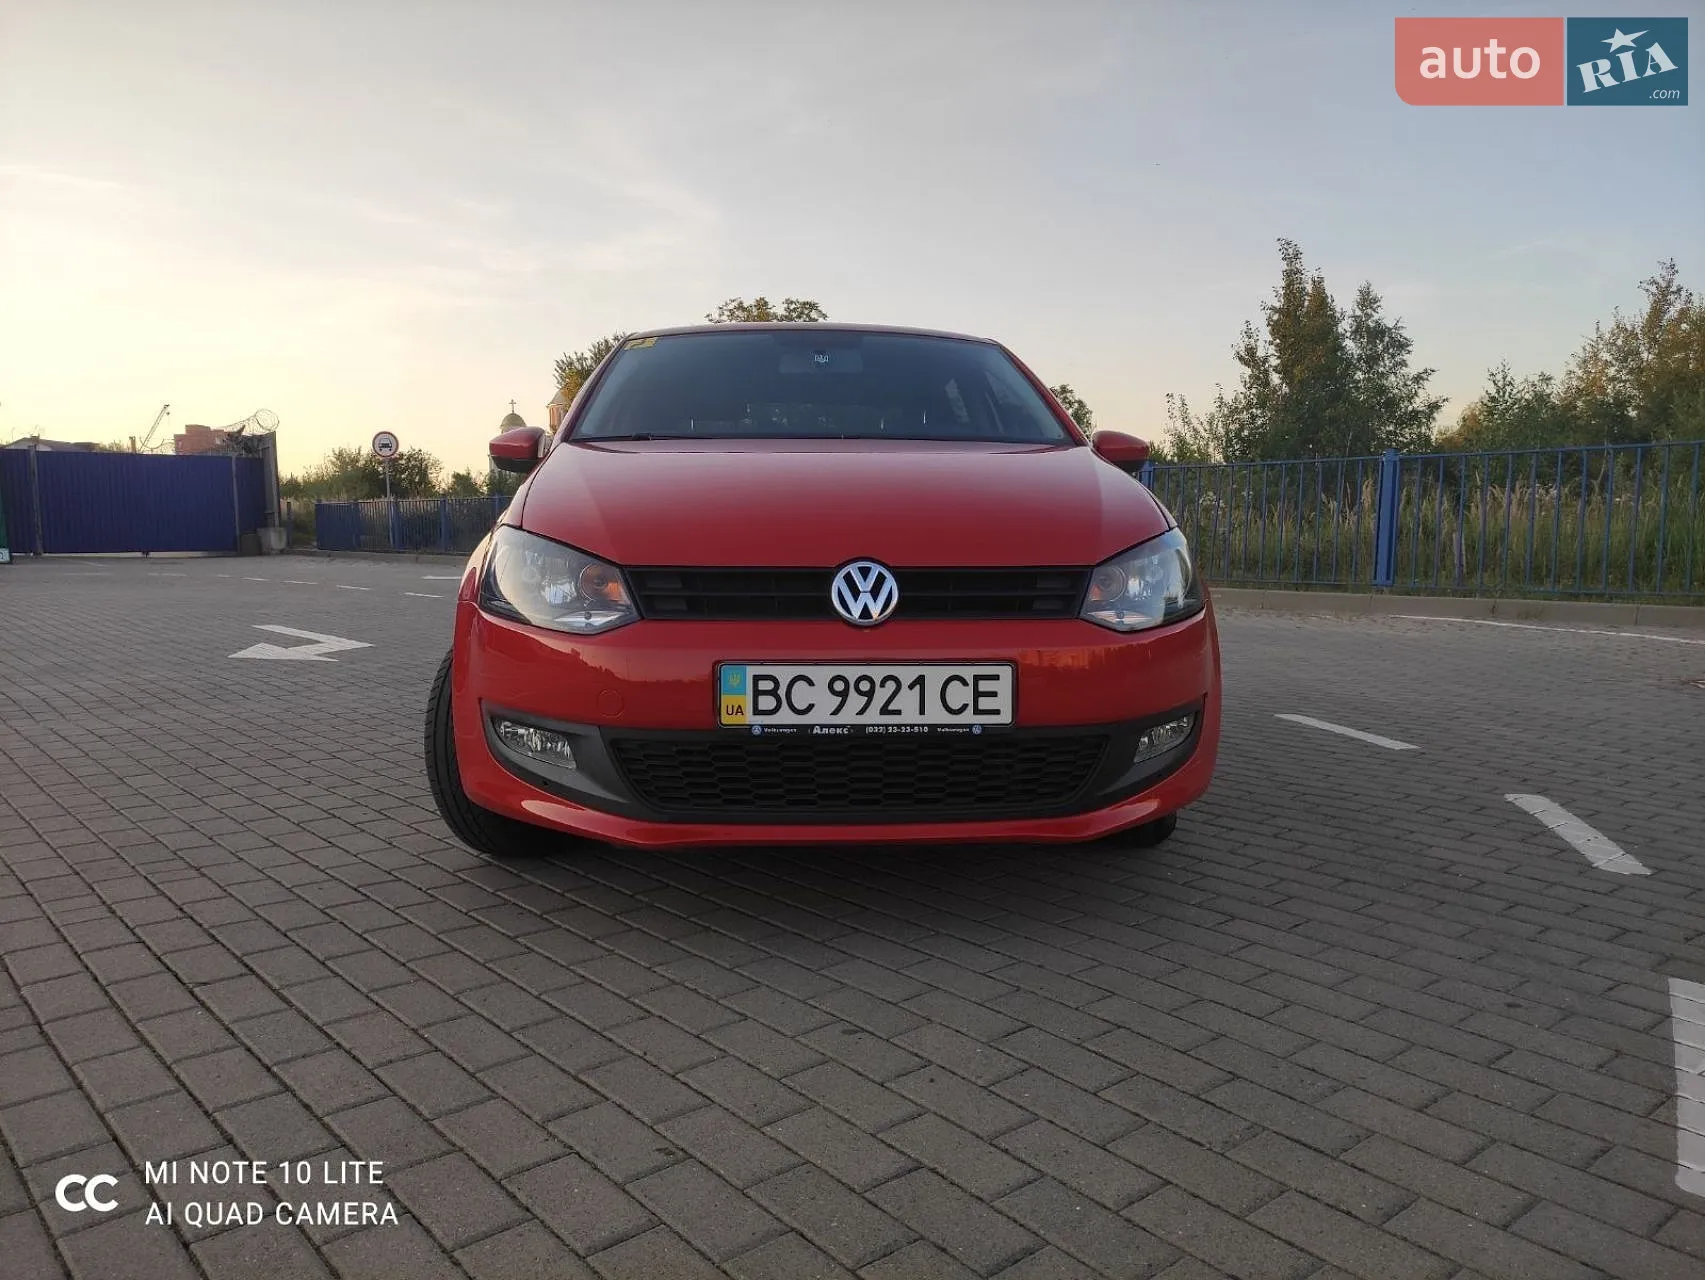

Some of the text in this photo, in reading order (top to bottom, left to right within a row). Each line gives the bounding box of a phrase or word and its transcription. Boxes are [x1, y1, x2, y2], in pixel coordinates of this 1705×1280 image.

[752, 674, 1001, 716] BC 9921 CE
[726, 704, 744, 716] UA
